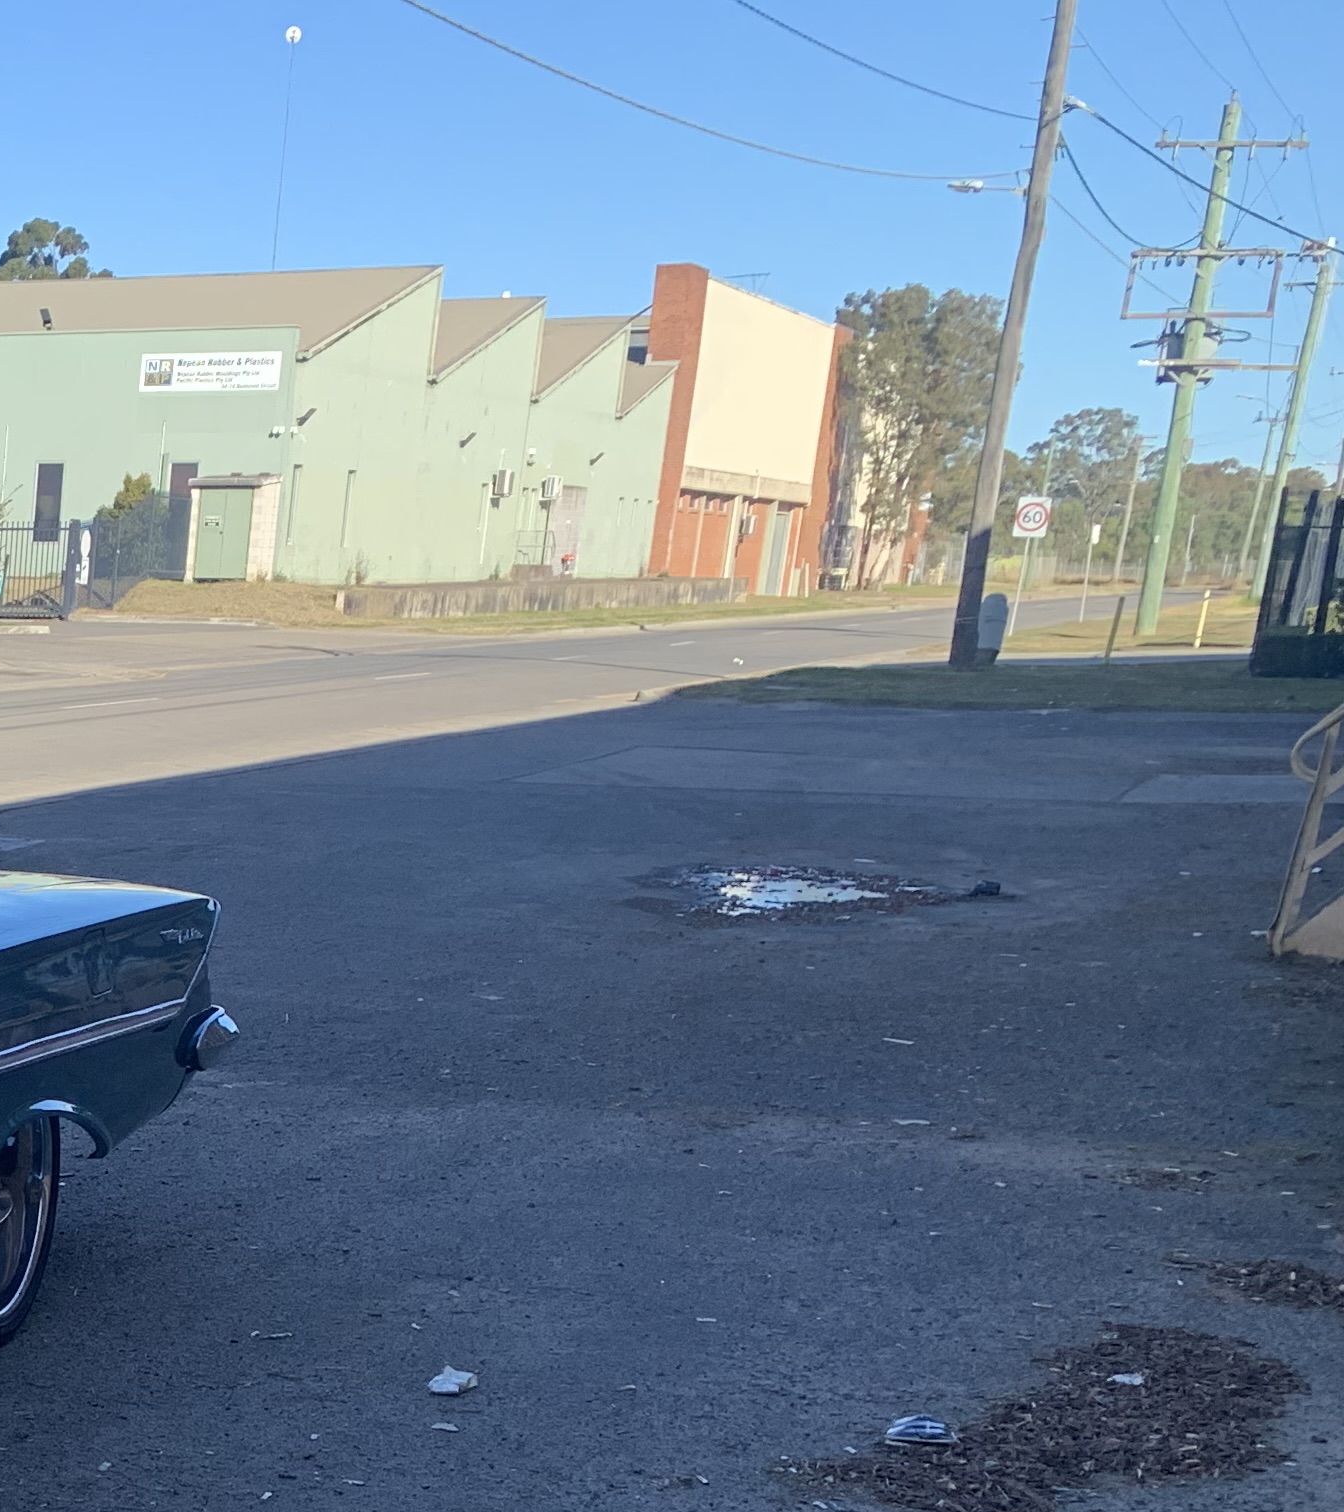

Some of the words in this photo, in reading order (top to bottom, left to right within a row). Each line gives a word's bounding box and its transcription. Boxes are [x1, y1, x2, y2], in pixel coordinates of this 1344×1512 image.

[208, 359, 235, 367] Rubber
[237, 358, 242, 366] &
[244, 357, 275, 366] Plastics
[1022, 510, 1043, 524] 60
